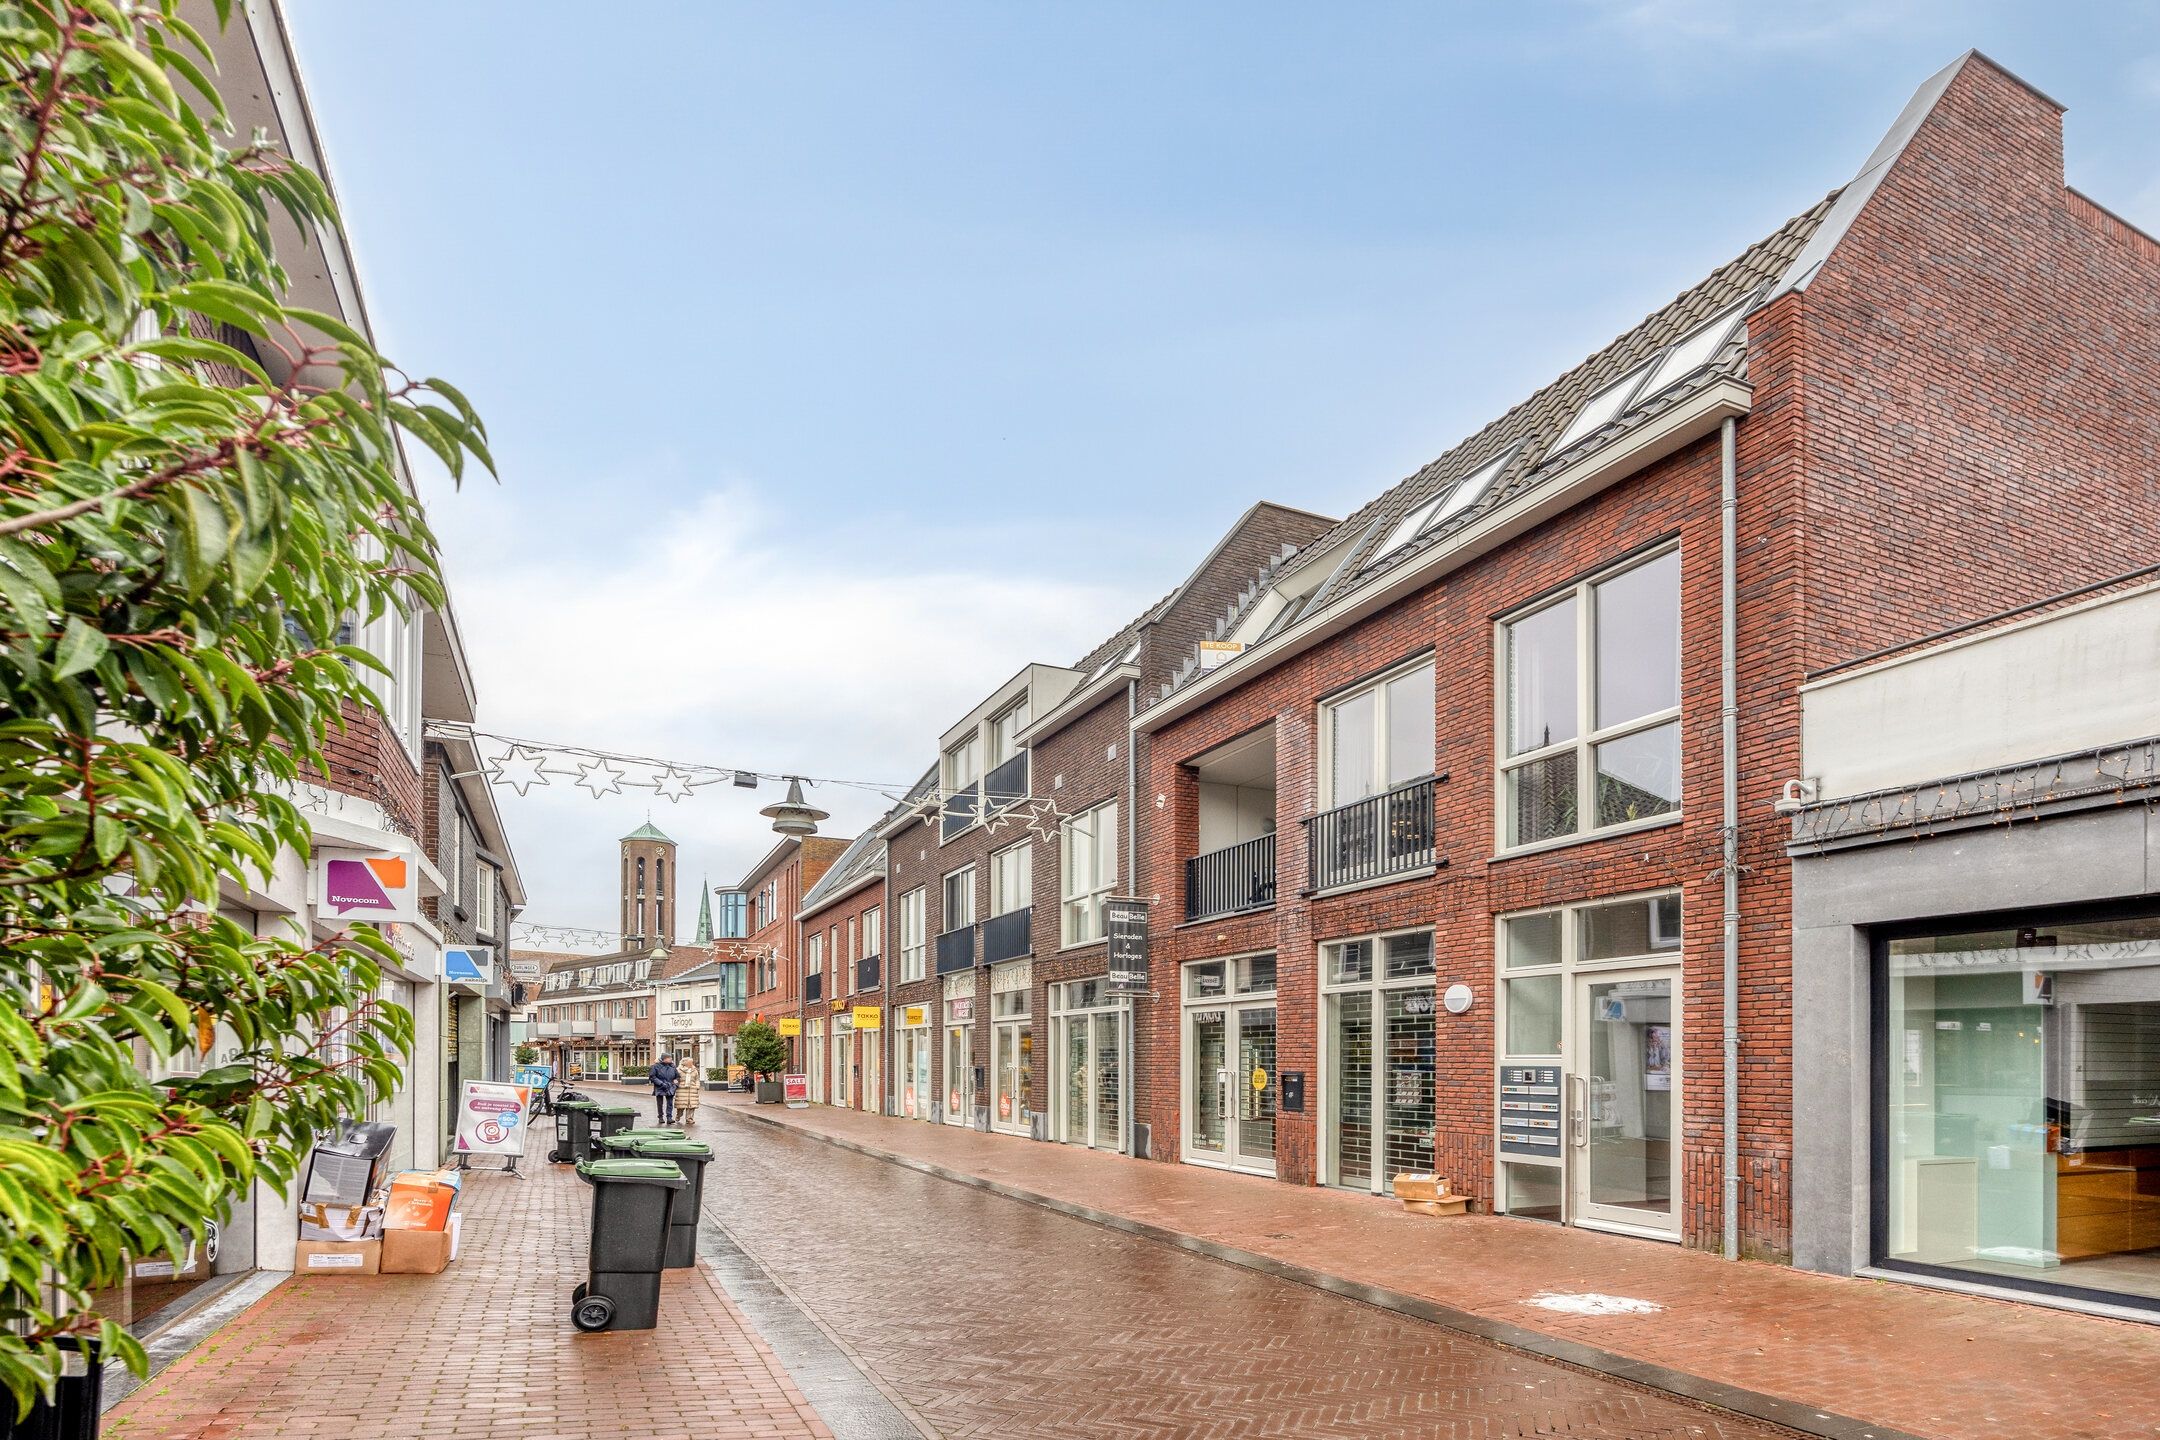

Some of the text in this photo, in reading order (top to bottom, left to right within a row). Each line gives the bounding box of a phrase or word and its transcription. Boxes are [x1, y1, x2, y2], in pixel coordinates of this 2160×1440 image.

[331, 895, 379, 904] Novocom
[1111, 911, 1145, 920] Beau Belle
[1113, 932, 1143, 941] Sieraden
[1113, 951, 1142, 960] Horloges
[1111, 972, 1128, 980] Beau
